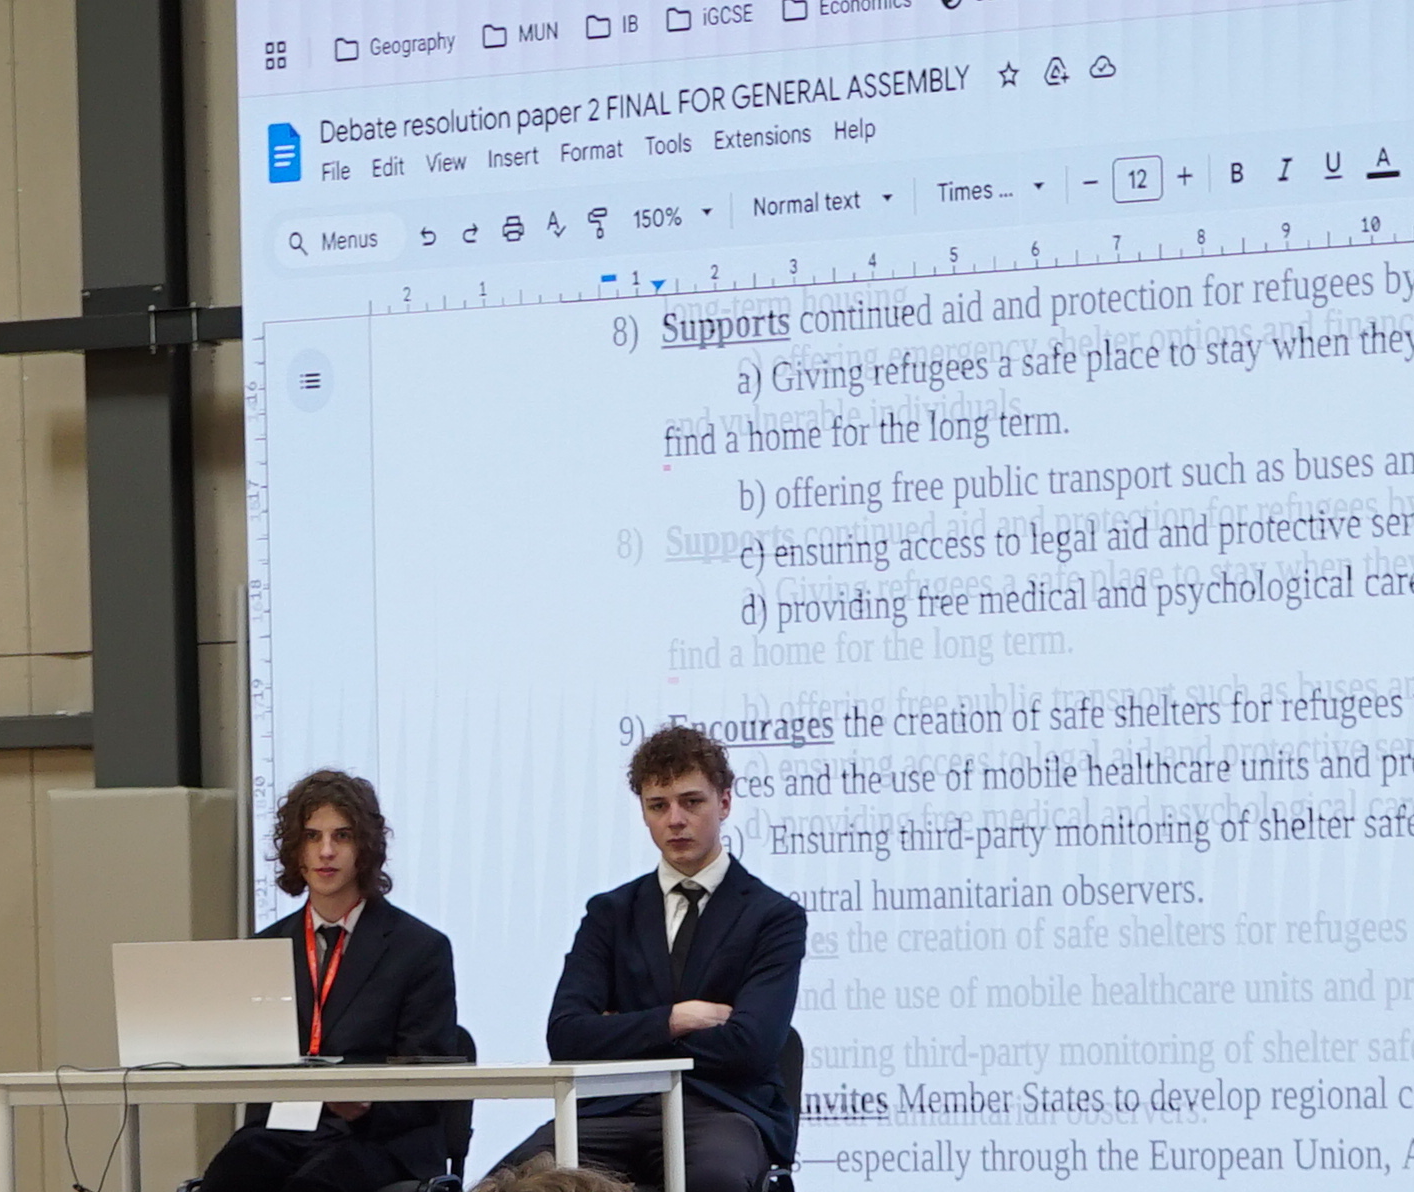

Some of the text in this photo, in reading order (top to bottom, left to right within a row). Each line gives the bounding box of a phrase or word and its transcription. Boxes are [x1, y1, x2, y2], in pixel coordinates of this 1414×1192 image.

[519, 22, 558, 42] MUN
[622, 15, 638, 34] IB
[703, 4, 754, 26] iGCSE
[370, 32, 455, 58] Geography
[320, 64, 970, 144] Debate resolution paper 2 FINAL FOR GENERAL ASSEMBLY
[322, 118, 876, 181] File Edit View Insert Format Tools Extensions Help
[937, 181, 993, 203] Times
[1128, 169, 1148, 190] 12
[633, 207, 682, 229] 150%
[753, 190, 861, 217] Normal text
[322, 228, 378, 251] Menus
[613, 315, 639, 354] 8)
[661, 309, 791, 349] Supports
[800, 294, 933, 335] continued
[941, 290, 983, 324] aid
[992, 286, 1040, 321] and
[1051, 278, 1193, 326] protection
[1203, 273, 1243, 307] for
[1253, 267, 1374, 309] refugees
[738, 362, 762, 402] a)
[772, 360, 864, 397] Giving
[873, 352, 988, 393] refugees
[1021, 342, 1077, 375] safe
[1086, 337, 1160, 382] place
[1170, 341, 1196, 367] to
[1206, 336, 1263, 373] stay
[1272, 326, 1350, 361] when
[664, 409, 1070, 457] find home for the long term.
[738, 478, 766, 518] b)
[776, 474, 882, 514] offering
[891, 471, 944, 504] free
[953, 464, 1039, 508] public
[1049, 460, 1172, 500] transport
[1182, 452, 1247, 489] such
[1256, 456, 1285, 484] as
[1294, 448, 1374, 481] buses
[740, 536, 765, 576] c)
[775, 532, 890, 572] ensuring
[899, 531, 986, 562] access
[994, 530, 1021, 557] to
[1030, 518, 1097, 563] legal
[1107, 517, 1149, 551] aid
[1159, 514, 1209, 549] and
[1218, 510, 1361, 555] protective
[742, 594, 768, 634] d)
[777, 589, 908, 633] providing
[918, 585, 969, 619] free
[979, 578, 1087, 616] medical
[1098, 575, 1147, 610] and
[1157, 565, 1353, 616] psychological
[843, 706, 884, 738] the
[893, 703, 1002, 736] creation
[1012, 700, 1041, 733] of
[1049, 697, 1105, 731] safe
[1114, 693, 1221, 728] shelters
[1231, 691, 1272, 724] for
[1281, 687, 1403, 729] refugees
[785, 764, 831, 798] and
[841, 762, 883, 795] the
[891, 768, 936, 794] use
[946, 759, 975, 792] of
[982, 755, 1077, 791] mobile
[1087, 752, 1231, 788] healthcare
[1241, 748, 1309, 783] units
[1319, 745, 1371, 780] and
[770, 824, 890, 861] Ensuring
[900, 817, 1045, 859] third-party
[1055, 814, 1211, 853] monitoring
[1221, 810, 1250, 843] of
[1259, 808, 1355, 843] shelter
[872, 873, 1204, 912] humanitarian observers.
[800, 1083, 890, 1120] nvites
[897, 1081, 1014, 1115] Member
[1023, 1082, 1105, 1115] States
[1114, 1087, 1140, 1111] to
[1150, 1078, 1261, 1119] develop
[1270, 1076, 1388, 1119] regional
[981, 1139, 1087, 1180] through
[1097, 1139, 1139, 1171] the
[1149, 1140, 1283, 1180] European
[1293, 1138, 1391, 1176] Union,
